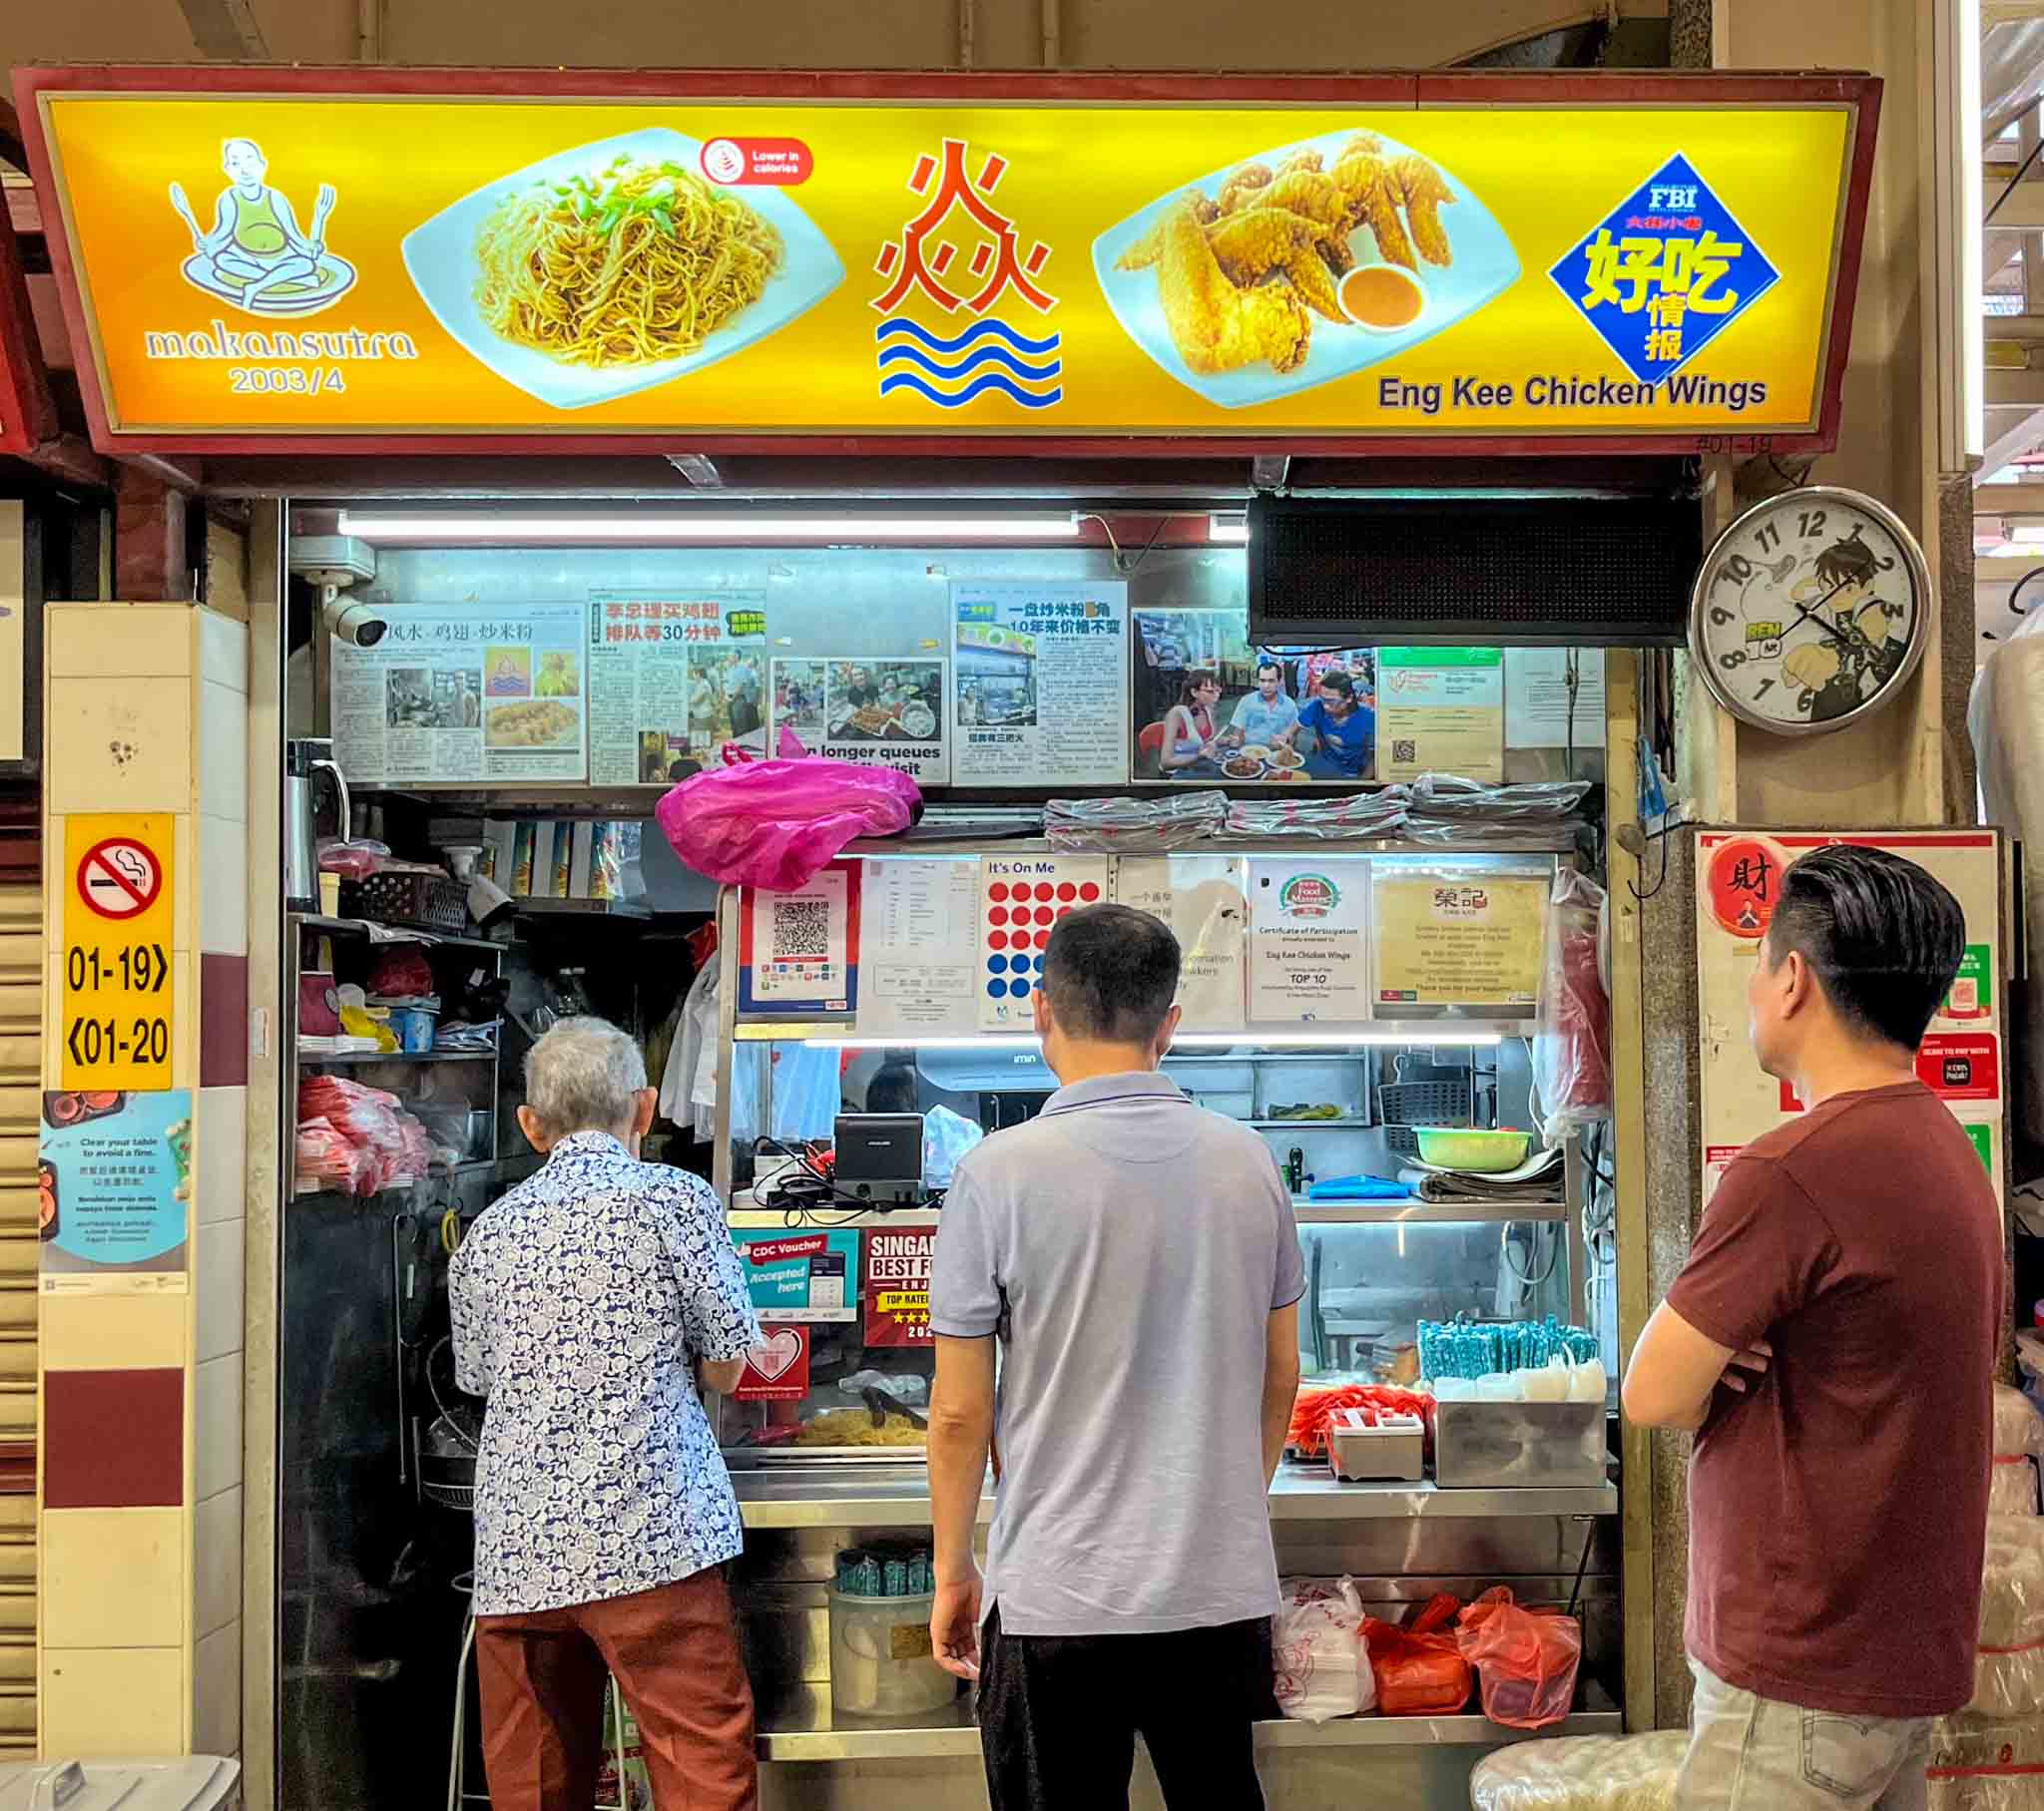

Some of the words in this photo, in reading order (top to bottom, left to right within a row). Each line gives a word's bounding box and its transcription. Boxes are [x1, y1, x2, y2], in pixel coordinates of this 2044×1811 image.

[753, 151, 786, 161] Lower
[788, 151, 799, 161] in
[754, 163, 798, 174] calories
[1649, 188, 1698, 209] FBI
[1581, 228, 1743, 313] 好吃
[1645, 293, 1687, 361] 情报
[144, 319, 418, 359] makansutra
[229, 367, 344, 394] 2003/4
[1378, 378, 1440, 413] Eng
[1452, 378, 1512, 406] Kee
[1524, 376, 1655, 405] Chicken
[1667, 376, 1766, 411] Wings
[1797, 510, 1826, 537] 12
[1754, 521, 1782, 554] 11
[1719, 554, 1753, 587] 10
[1710, 606, 1736, 627] 9
[1720, 650, 1747, 671] 8
[1753, 678, 1777, 700] 7
[821, 744, 875, 760] longer
[879, 747, 940, 760] queues
[989, 862, 1009, 874] It's
[1013, 862, 1031, 874] On
[1036, 862, 1055, 874] Me
[1300, 926, 1308, 935] of
[1310, 927, 1358, 936] Participation
[1327, 951, 1350, 960] Wings
[69, 945, 151, 991] 01-19
[1290, 974, 1309, 984] TOP
[1314, 974, 1326, 984] 10
[84, 1018, 168, 1064] 01-20
[80, 1137, 105, 1147] Clear
[107, 1139, 130, 1149] your
[132, 1137, 159, 1147] table
[83, 1149, 94, 1158] to
[97, 1148, 124, 1158] avoid
[134, 1148, 157, 1158] fine.
[753, 1245, 776, 1257] CDC
[778, 1239, 821, 1254] Voucher
[750, 1265, 806, 1284] Accepted
[873, 1258, 915, 1277] BEST
[920, 1258, 934, 1277] F
[777, 1281, 805, 1294] here
[886, 1294, 902, 1304] TOP
